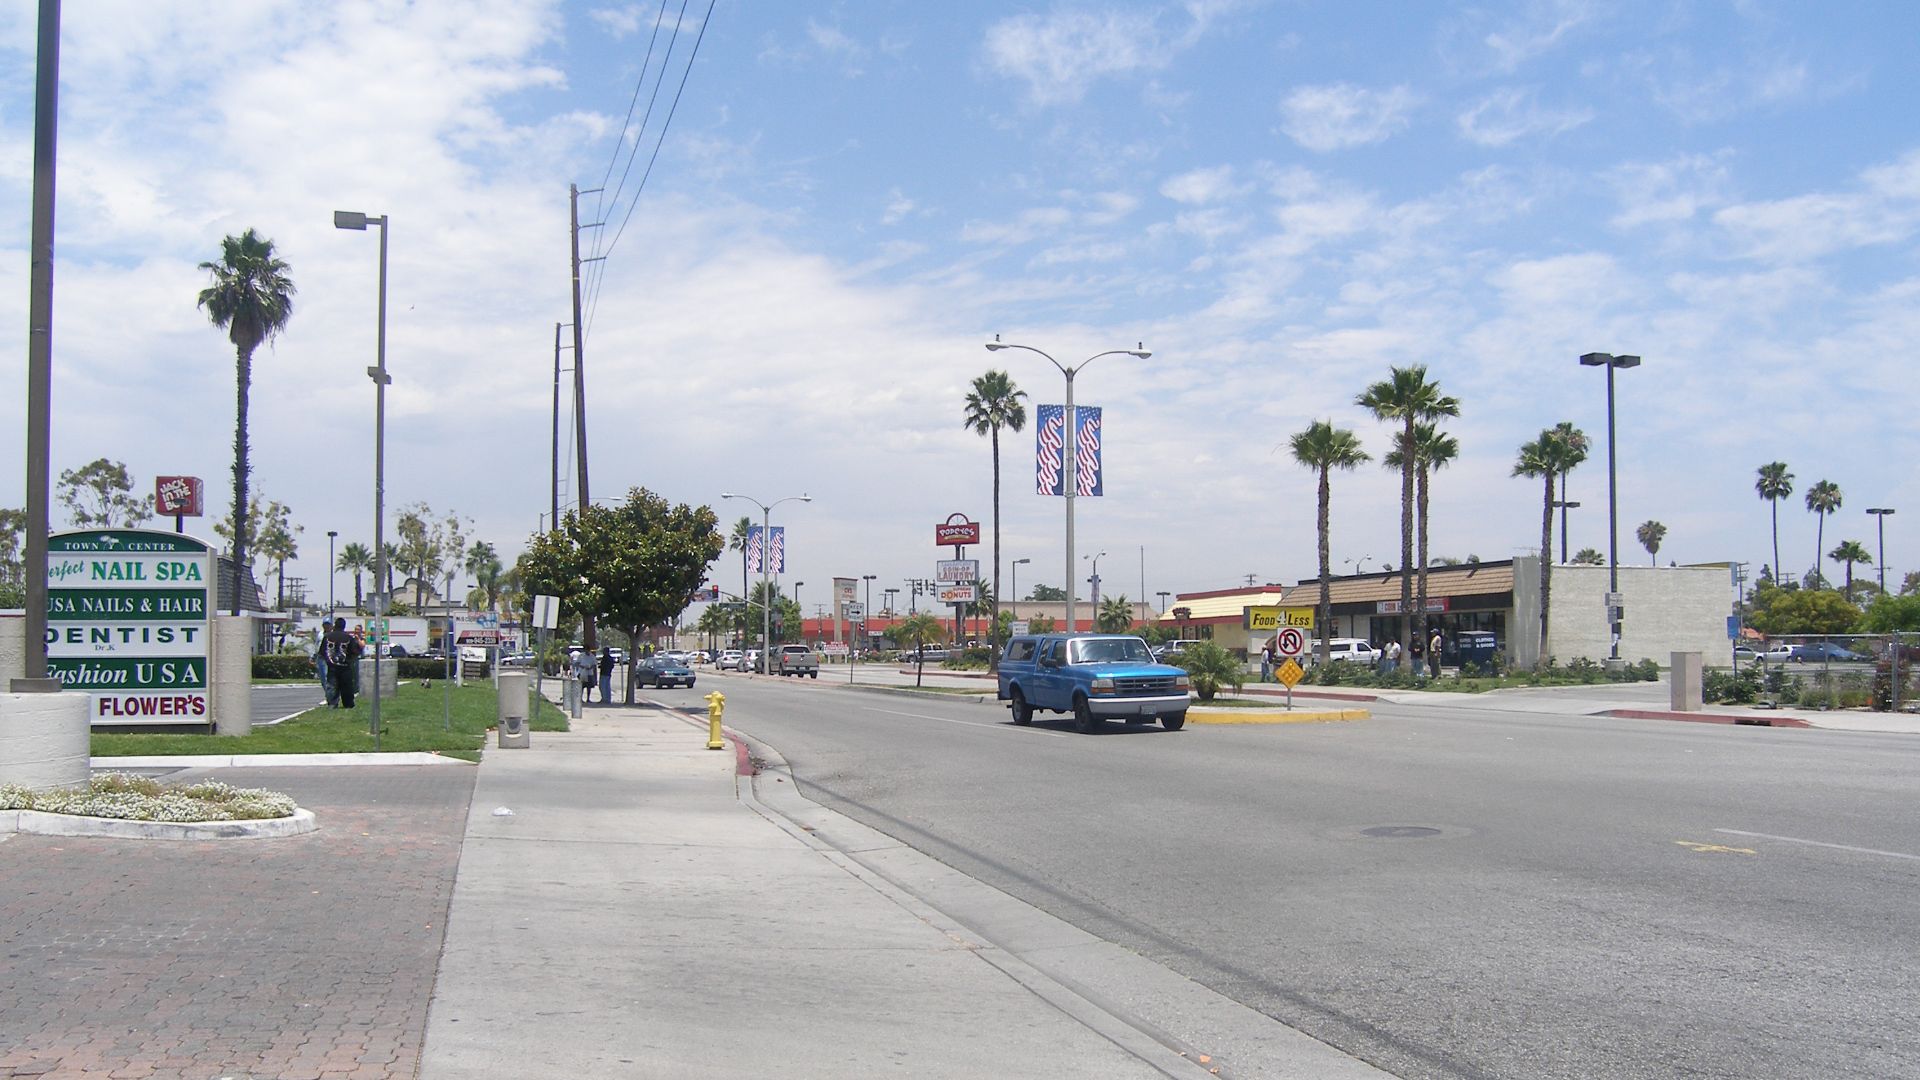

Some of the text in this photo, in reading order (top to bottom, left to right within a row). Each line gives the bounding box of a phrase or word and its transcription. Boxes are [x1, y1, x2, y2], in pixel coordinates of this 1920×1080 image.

[160, 478, 186, 493] JACK
[173, 486, 191, 499] THE
[939, 527, 975, 536] POPEYES
[65, 542, 176, 551] TOWN CENTER
[48, 560, 203, 582] erfect NAIL SPA
[938, 571, 975, 581] LAUNDRY
[941, 590, 972, 599] DONUTS
[82, 598, 134, 612] NAILS
[140, 598, 153, 612] &
[159, 598, 203, 612] HAIR
[1253, 610, 1309, 626] FOOD 4 LESS
[99, 695, 206, 716] FLOWER'S
